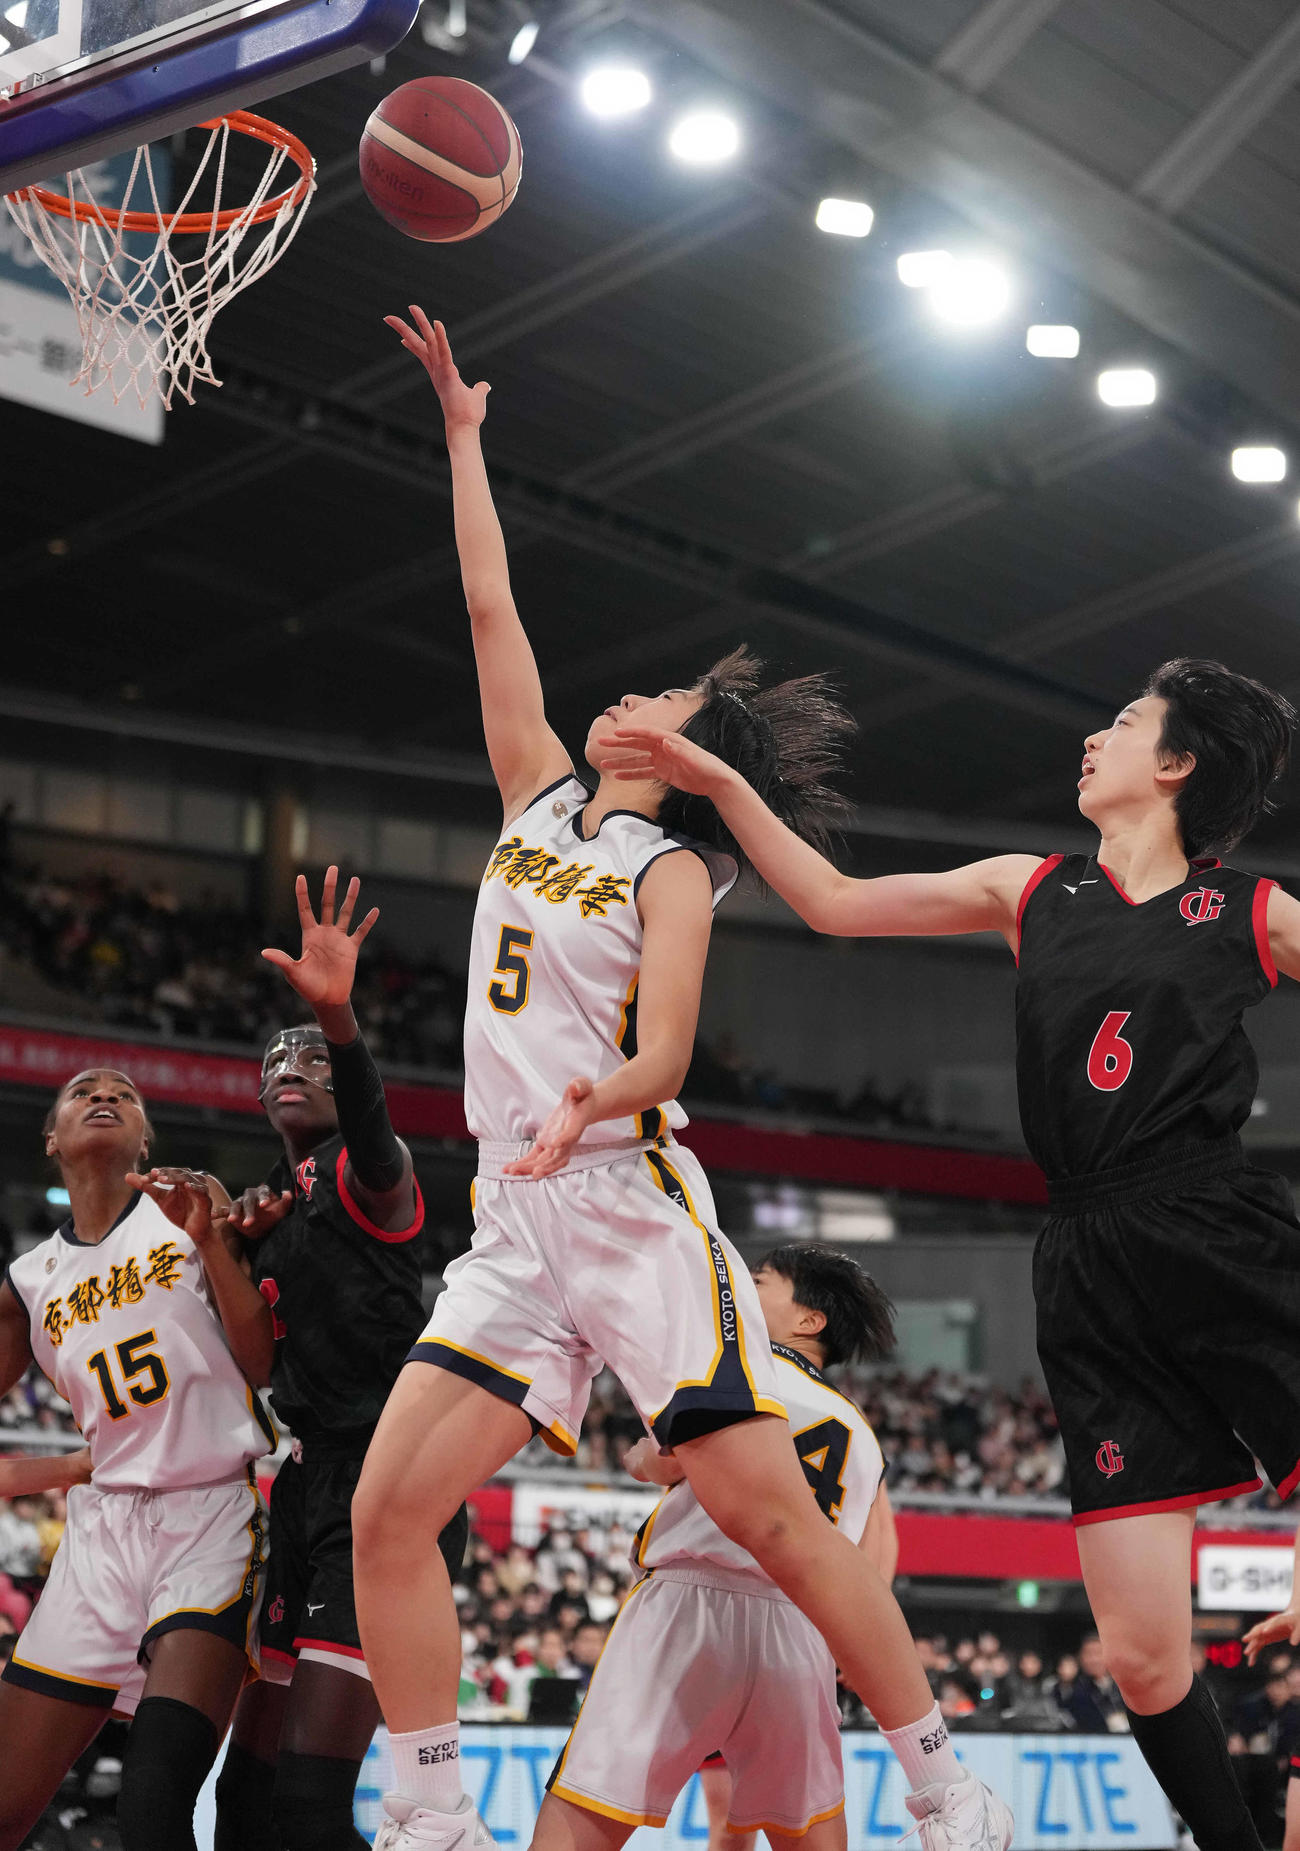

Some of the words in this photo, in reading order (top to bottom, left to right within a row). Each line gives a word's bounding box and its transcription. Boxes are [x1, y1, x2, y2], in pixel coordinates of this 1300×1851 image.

[487, 923, 535, 1017] 5
[1087, 1011, 1133, 1092] 6
[711, 1241, 729, 1284] SEIKA
[720, 1290, 737, 1341] KYOTO
[86, 1327, 172, 1422] 15
[418, 1739, 458, 1756] KYOT
[1021, 1752, 1138, 1834] ZTE
